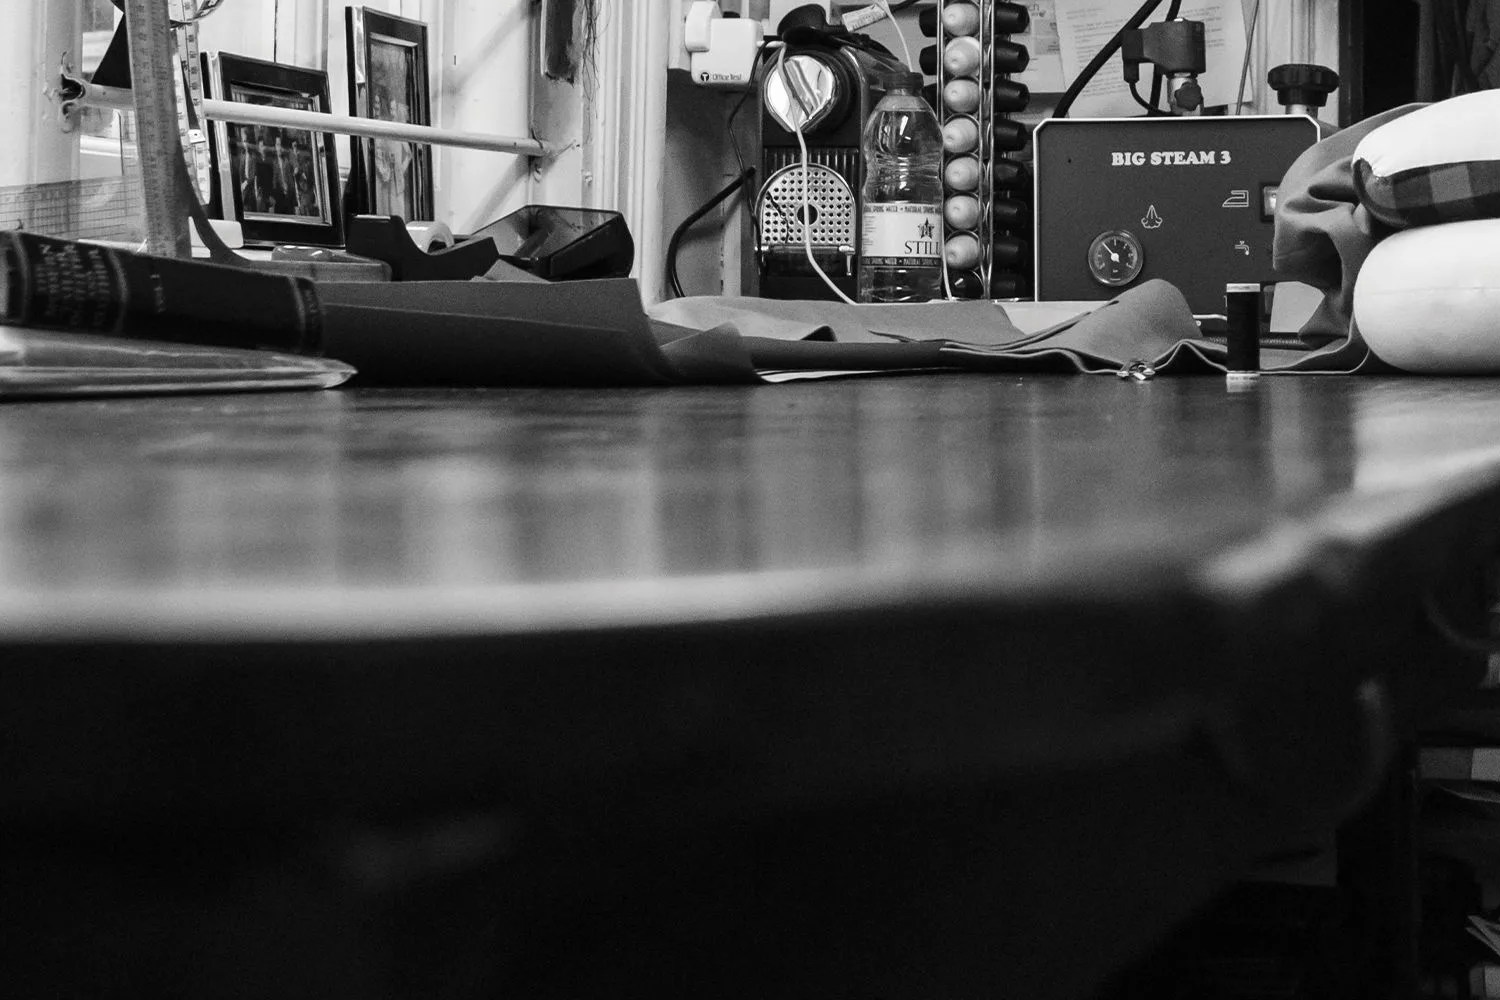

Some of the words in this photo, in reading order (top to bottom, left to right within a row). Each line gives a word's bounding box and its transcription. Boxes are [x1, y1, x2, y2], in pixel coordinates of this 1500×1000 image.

[1111, 152, 1146, 166] BIG
[1150, 151, 1216, 165] STEAM
[1220, 150, 1232, 165] 3
